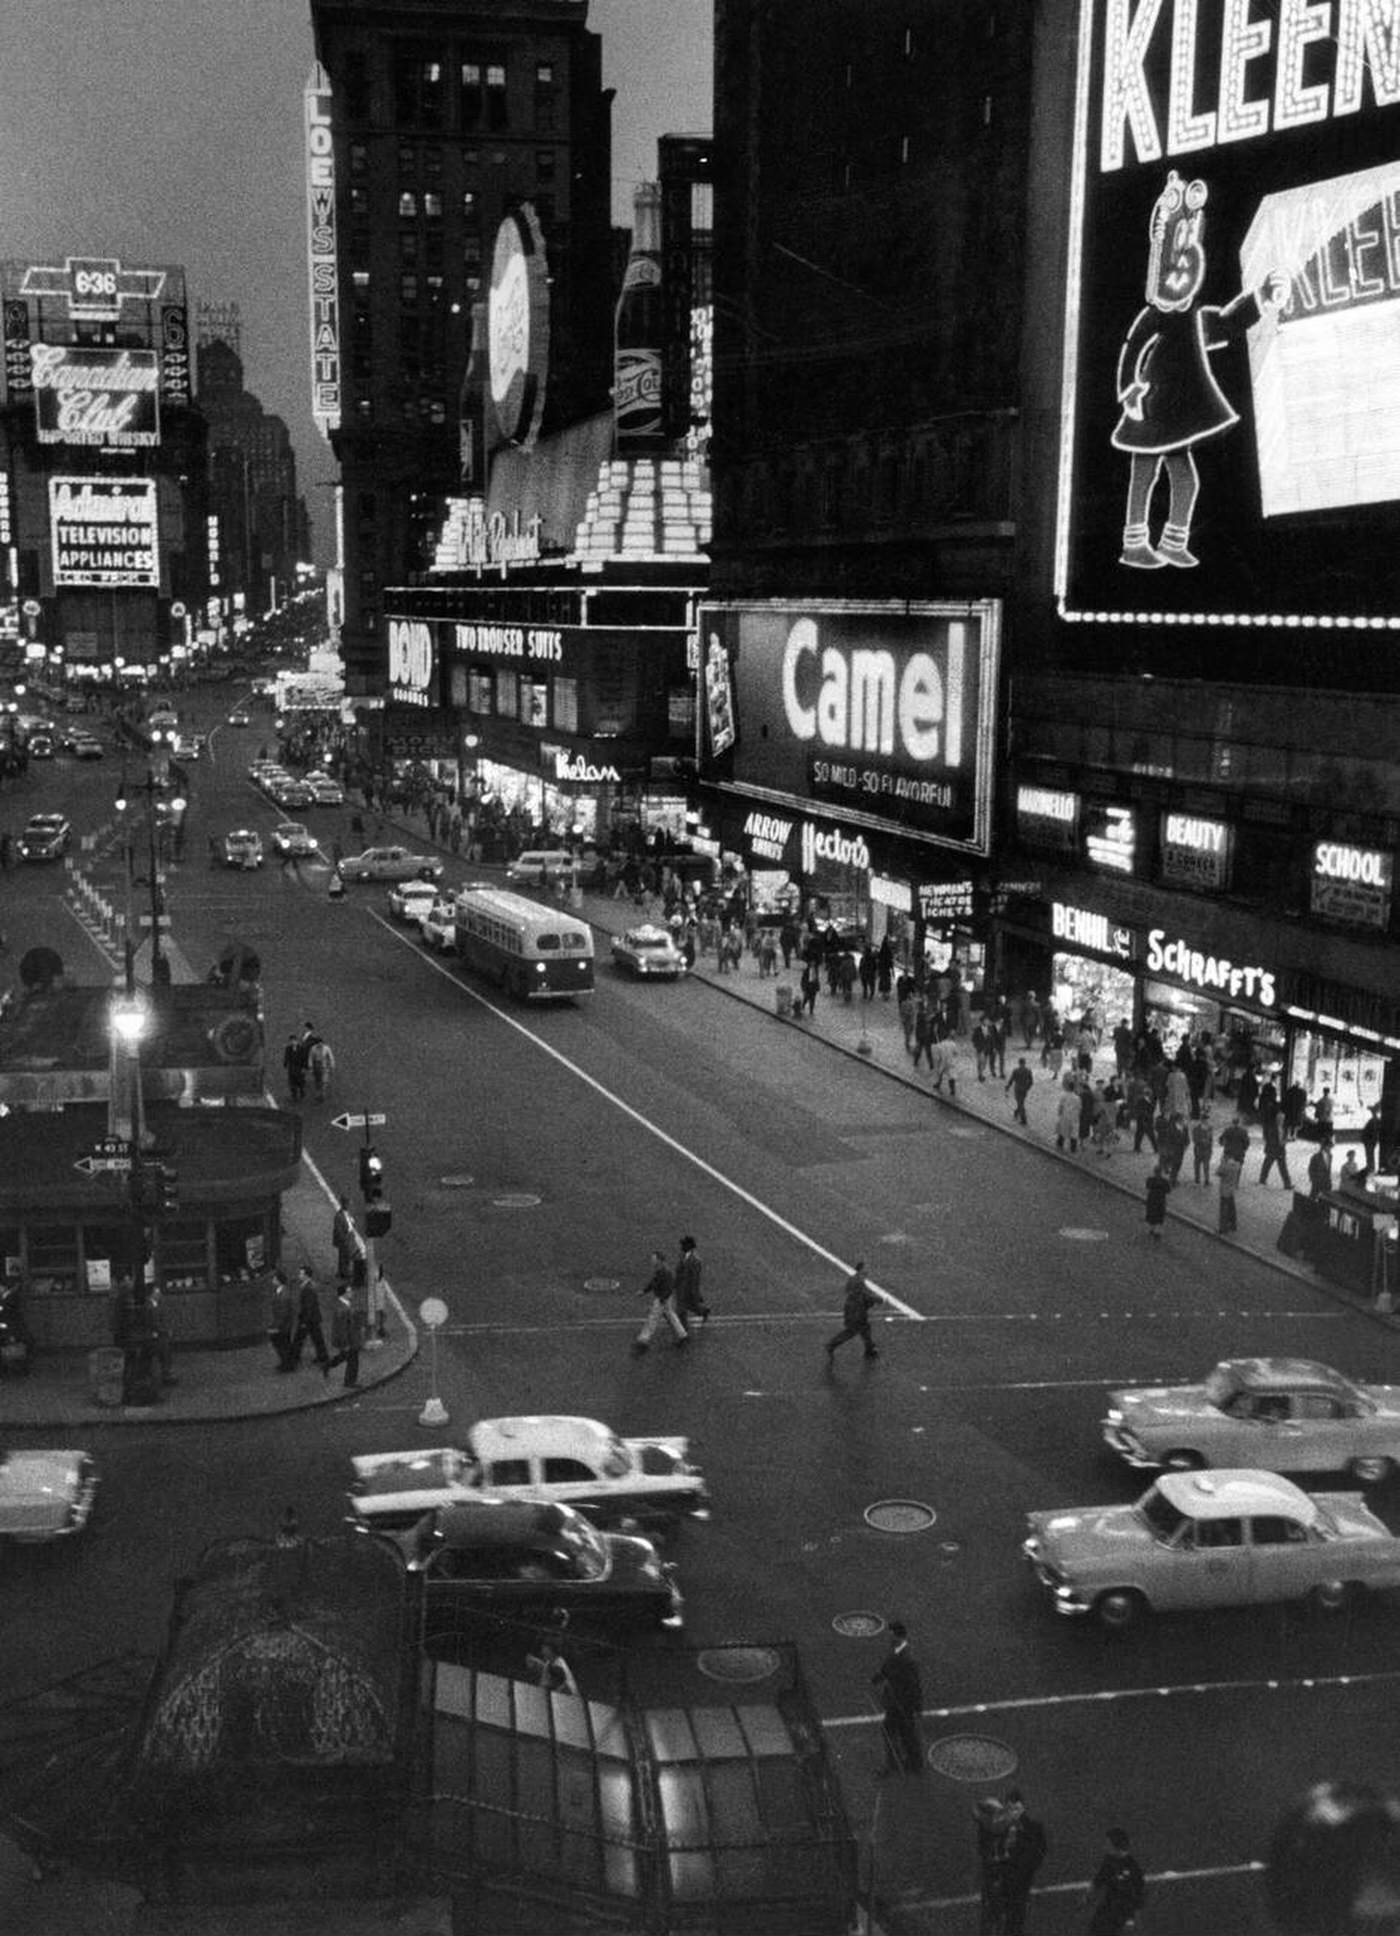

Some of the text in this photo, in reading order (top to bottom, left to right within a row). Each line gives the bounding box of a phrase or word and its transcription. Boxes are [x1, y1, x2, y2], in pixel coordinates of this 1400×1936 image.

[1100, 0, 1400, 173] KLEEN
[75, 270, 117, 294] 636
[312, 260, 337, 410] STATE
[29, 342, 159, 391] Canadian
[57, 389, 138, 432] Club
[38, 429, 105, 445] IMPORTED
[59, 526, 151, 545] TELEVISION
[60, 550, 152, 569] APPLIANCES
[389, 620, 432, 688] BOND
[455, 624, 562, 661] TWO TROUSER SUITS
[781, 616, 965, 767] Camel
[743, 811, 793, 846] ARROW
[801, 820, 870, 876] Hector's
[1166, 814, 1225, 852] BEAUTY
[1315, 843, 1385, 887] SCHOOL
